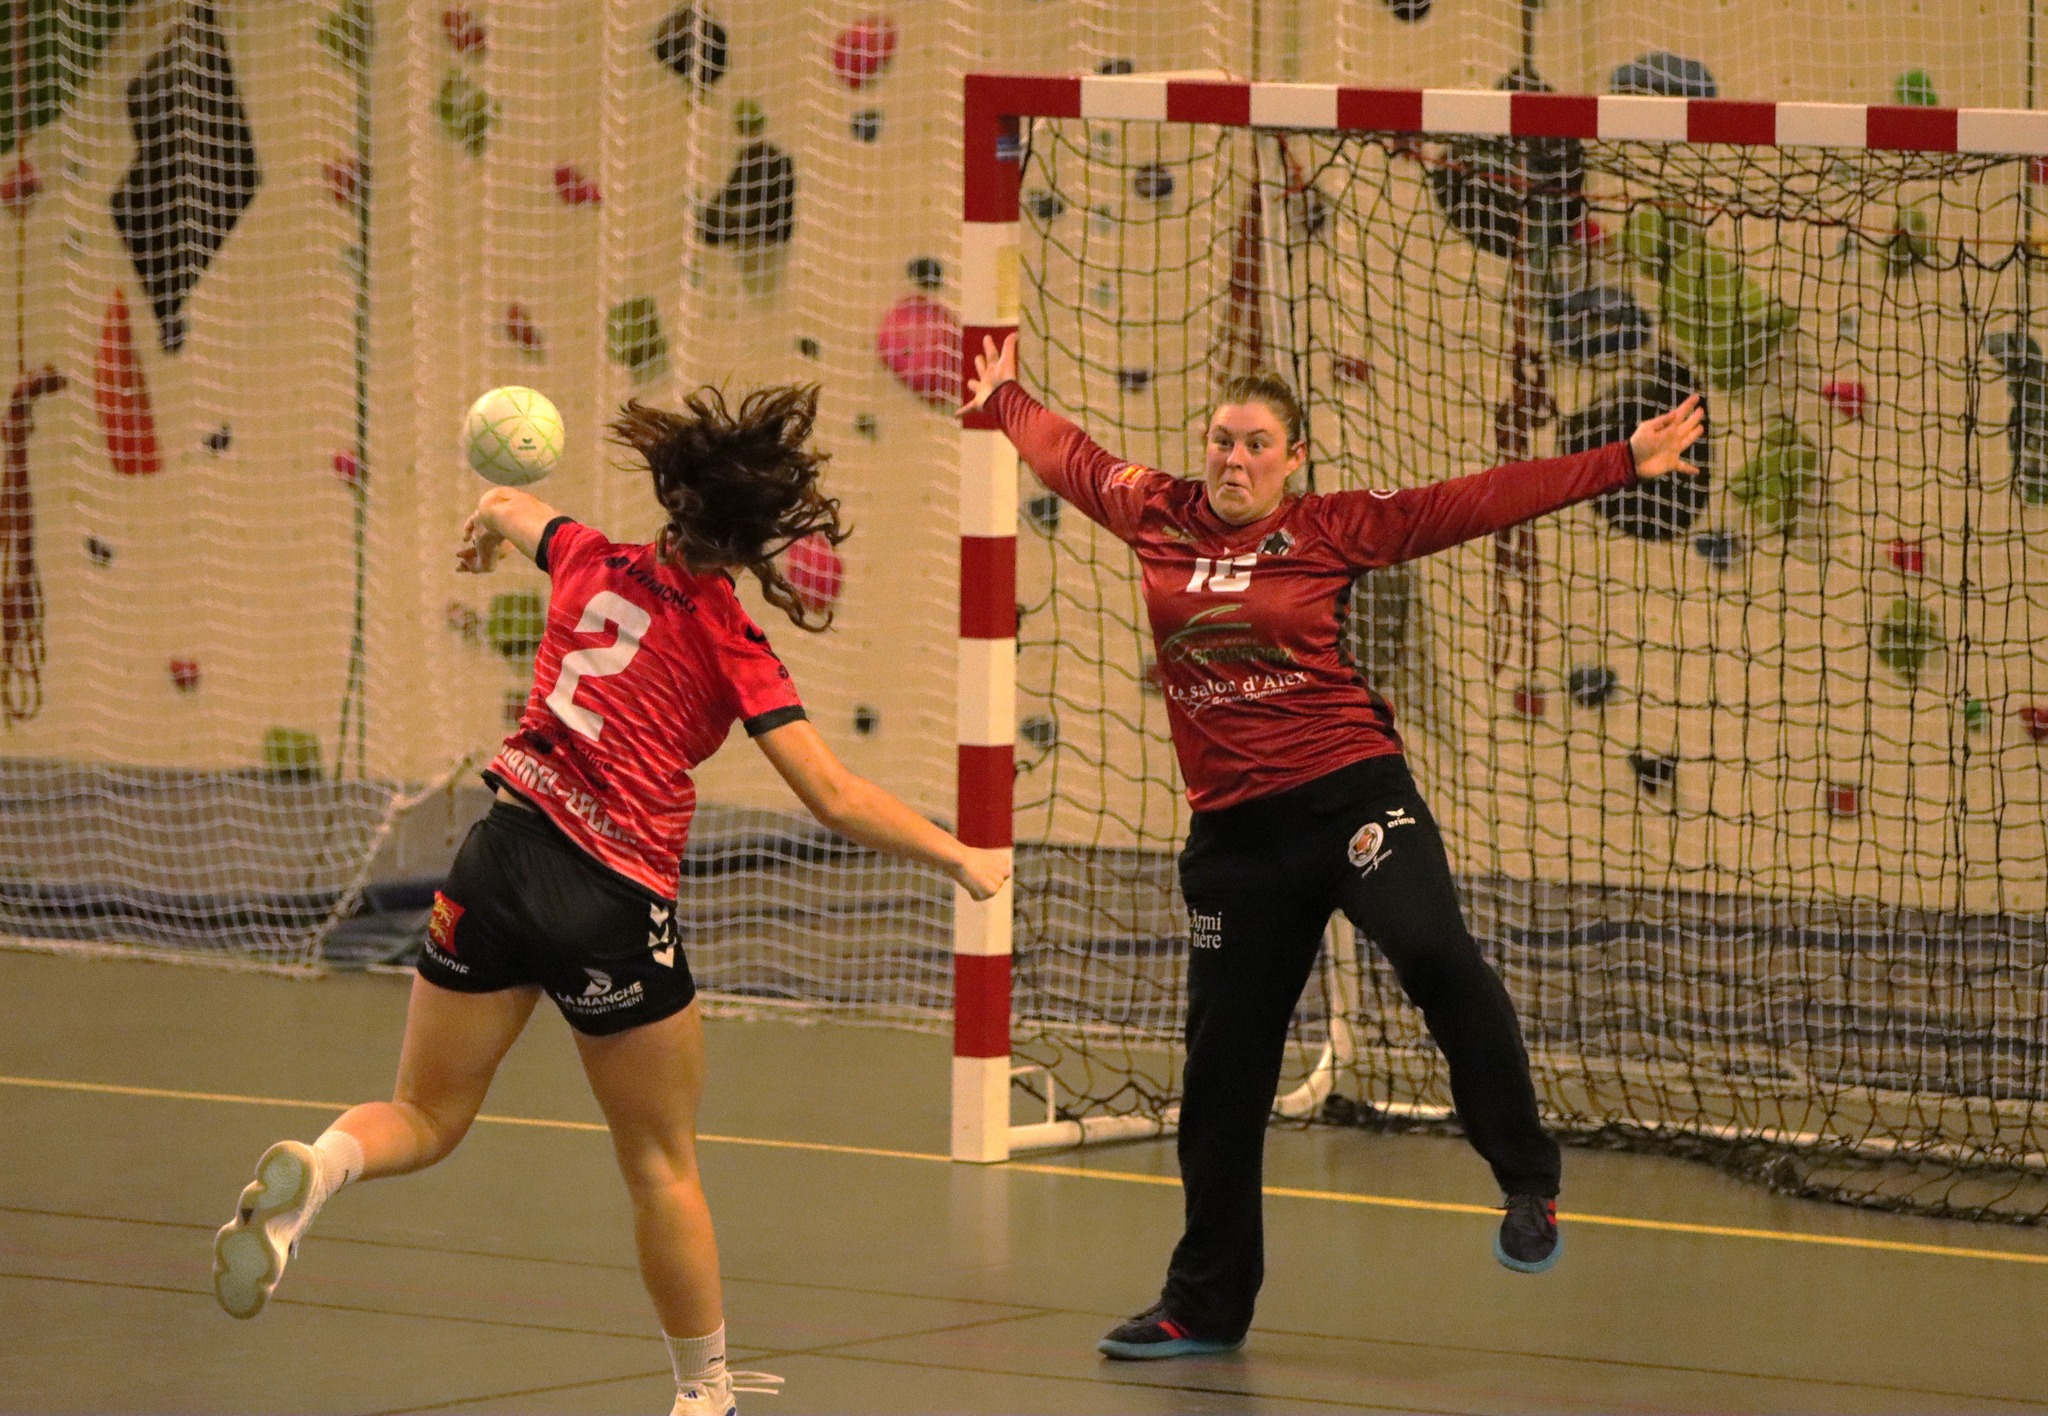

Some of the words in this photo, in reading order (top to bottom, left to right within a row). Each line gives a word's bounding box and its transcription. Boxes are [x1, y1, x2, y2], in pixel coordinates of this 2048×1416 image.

[545, 590, 652, 742] 2
[1189, 678, 1237, 699] salon
[1242, 671, 1308, 693] d'Alex
[1387, 816, 1416, 829] erima
[556, 991, 575, 1006] LA
[576, 980, 643, 1007] MANCHE
